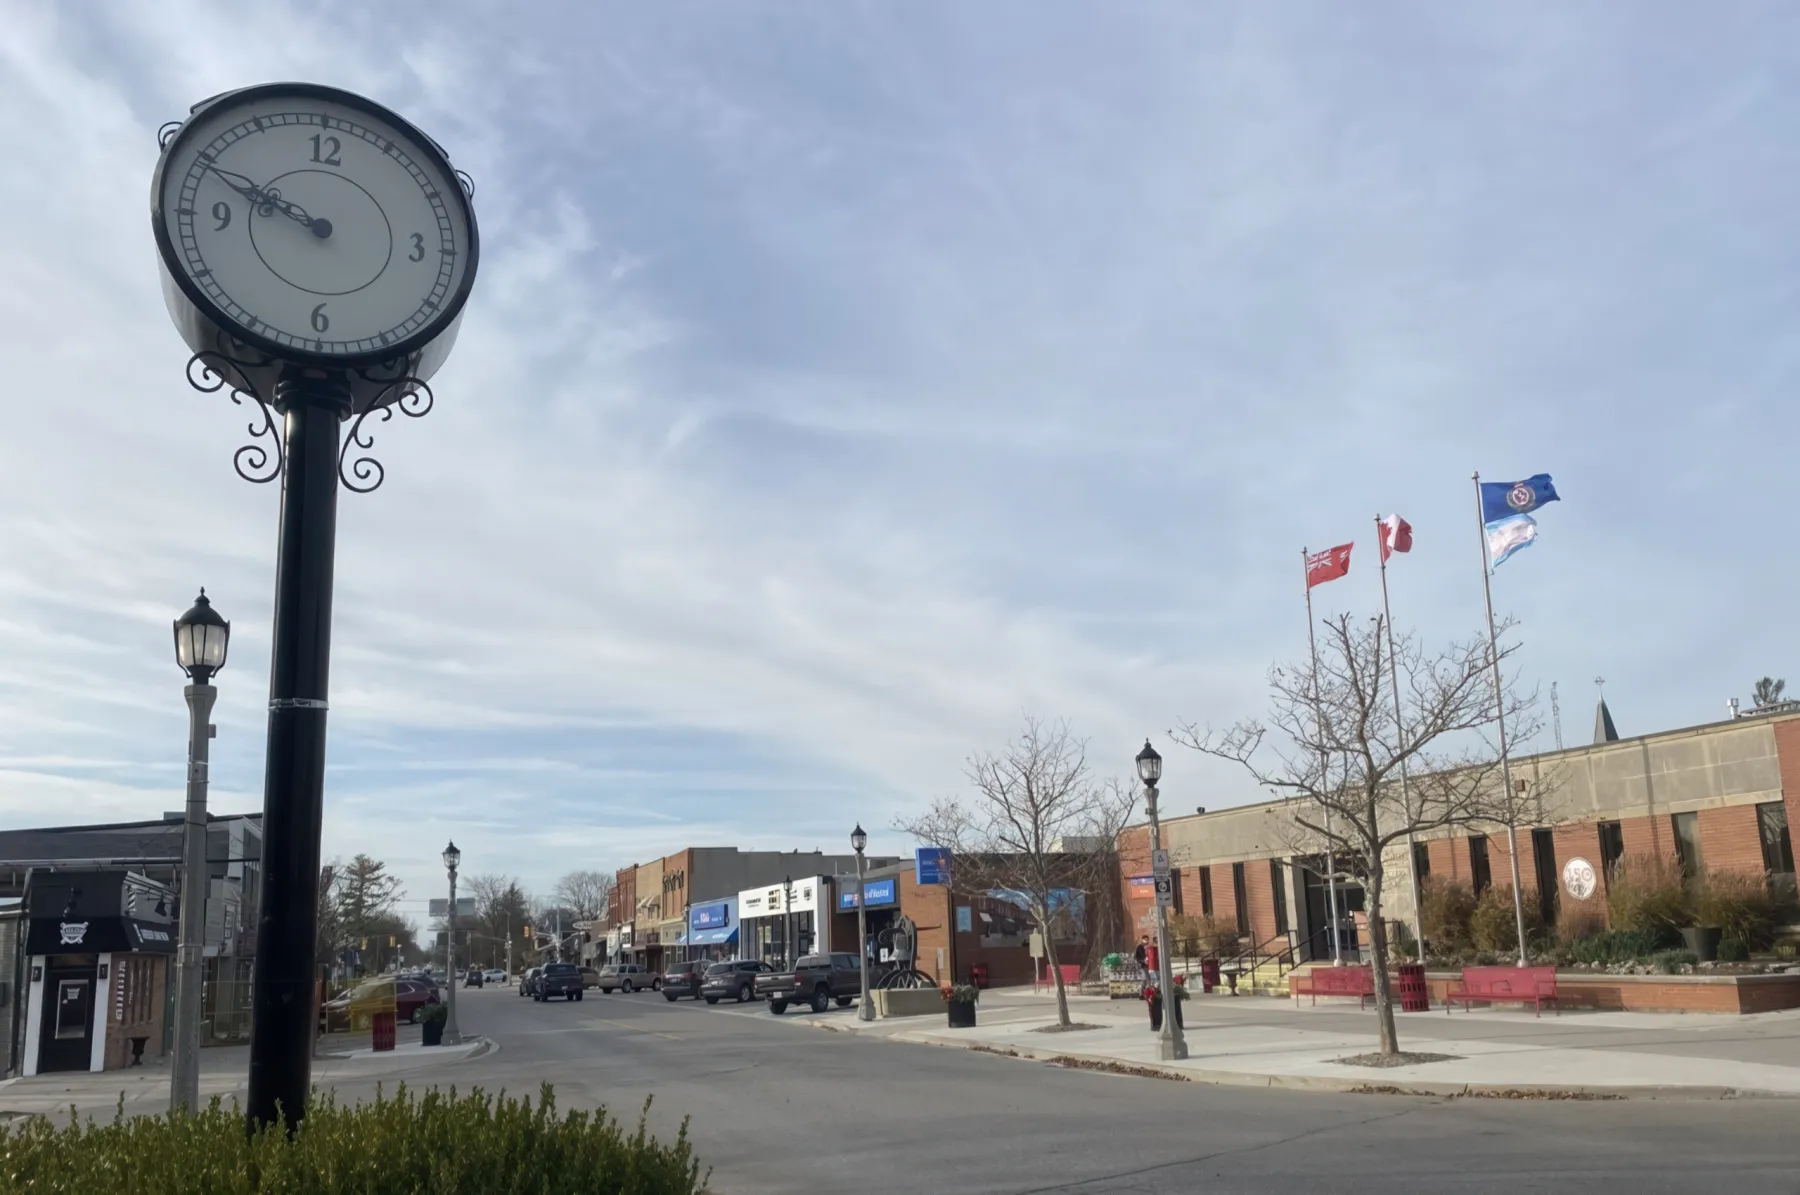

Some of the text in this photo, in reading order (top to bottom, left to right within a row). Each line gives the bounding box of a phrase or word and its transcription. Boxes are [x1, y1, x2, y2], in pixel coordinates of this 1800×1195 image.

[308, 134, 341, 167] 12
[212, 202, 231, 231] 9
[408, 233, 425, 263] 3
[310, 302, 330, 333] 6
